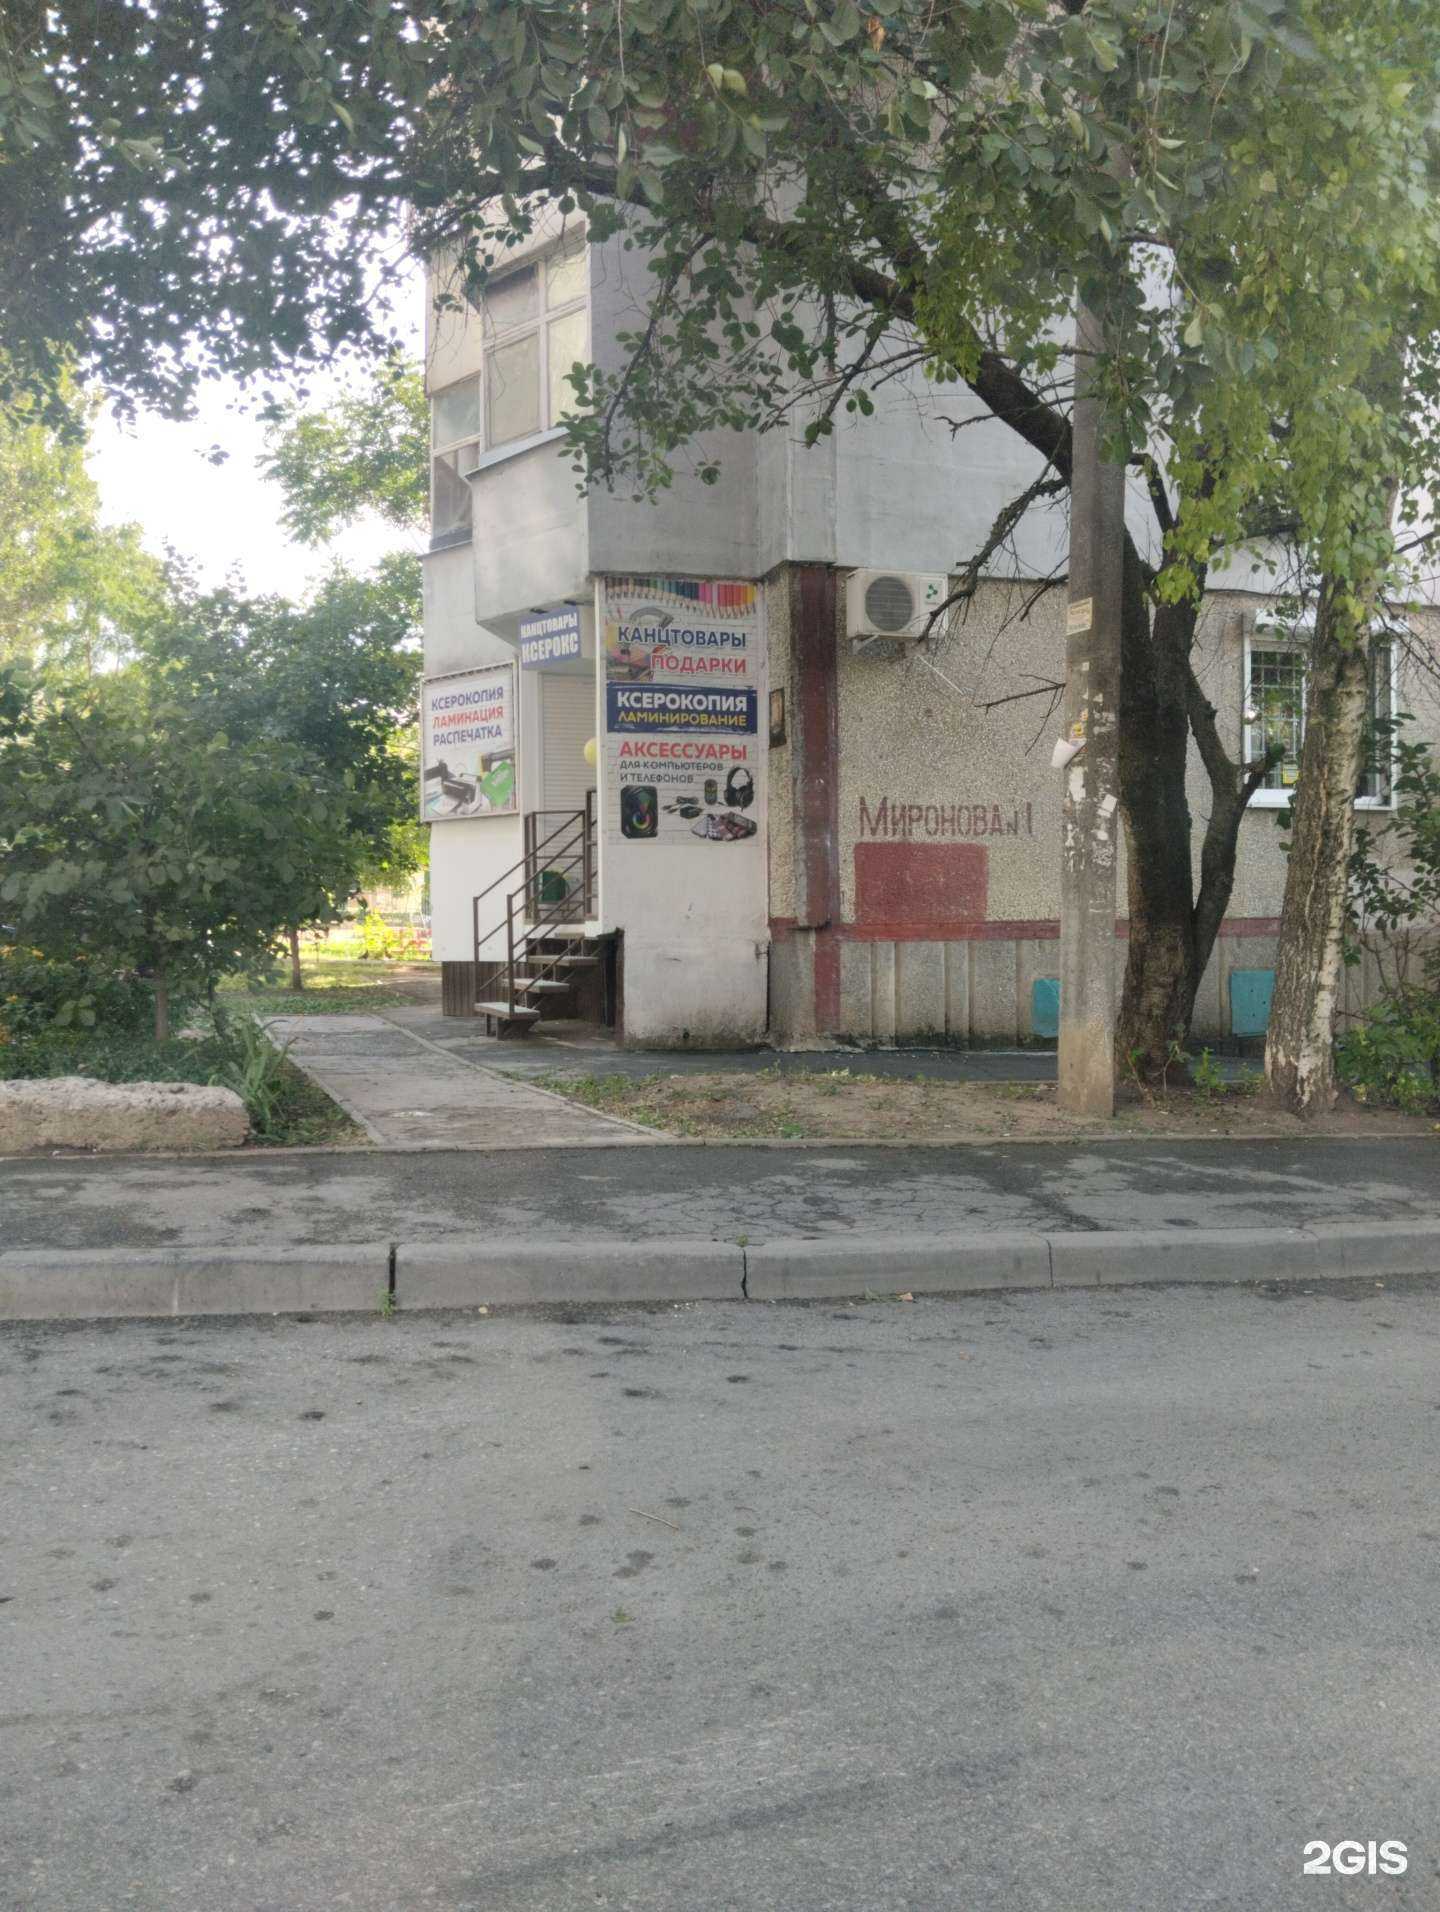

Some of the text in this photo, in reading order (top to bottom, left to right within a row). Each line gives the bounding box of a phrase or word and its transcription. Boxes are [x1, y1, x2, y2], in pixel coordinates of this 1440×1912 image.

[520, 613, 577, 638] КАНЦТОВАРЫ
[618, 626, 746, 648] КАНЦТОВАРЫ
[522, 633, 578, 663] КСЕРОКС
[651, 655, 746, 673] ПОДАРКИ
[431, 686, 503, 711] КСЕРОКОПИЯ
[617, 692, 747, 711] КСЕРОКОПИЯ
[432, 706, 503, 729] ЛАМИНАЦИЯ
[618, 712, 746, 727] ЛАМИНИРОВАНИЕ
[433, 725, 502, 746] РАСПЕЧАТКА
[620, 742, 746, 760] АКСЕССУАРЫ
[620, 761, 723, 771] ДЛЯ КОМПЬЮТЕРОВ
[630, 774, 693, 783] ТЕЛЕФОНОВ
